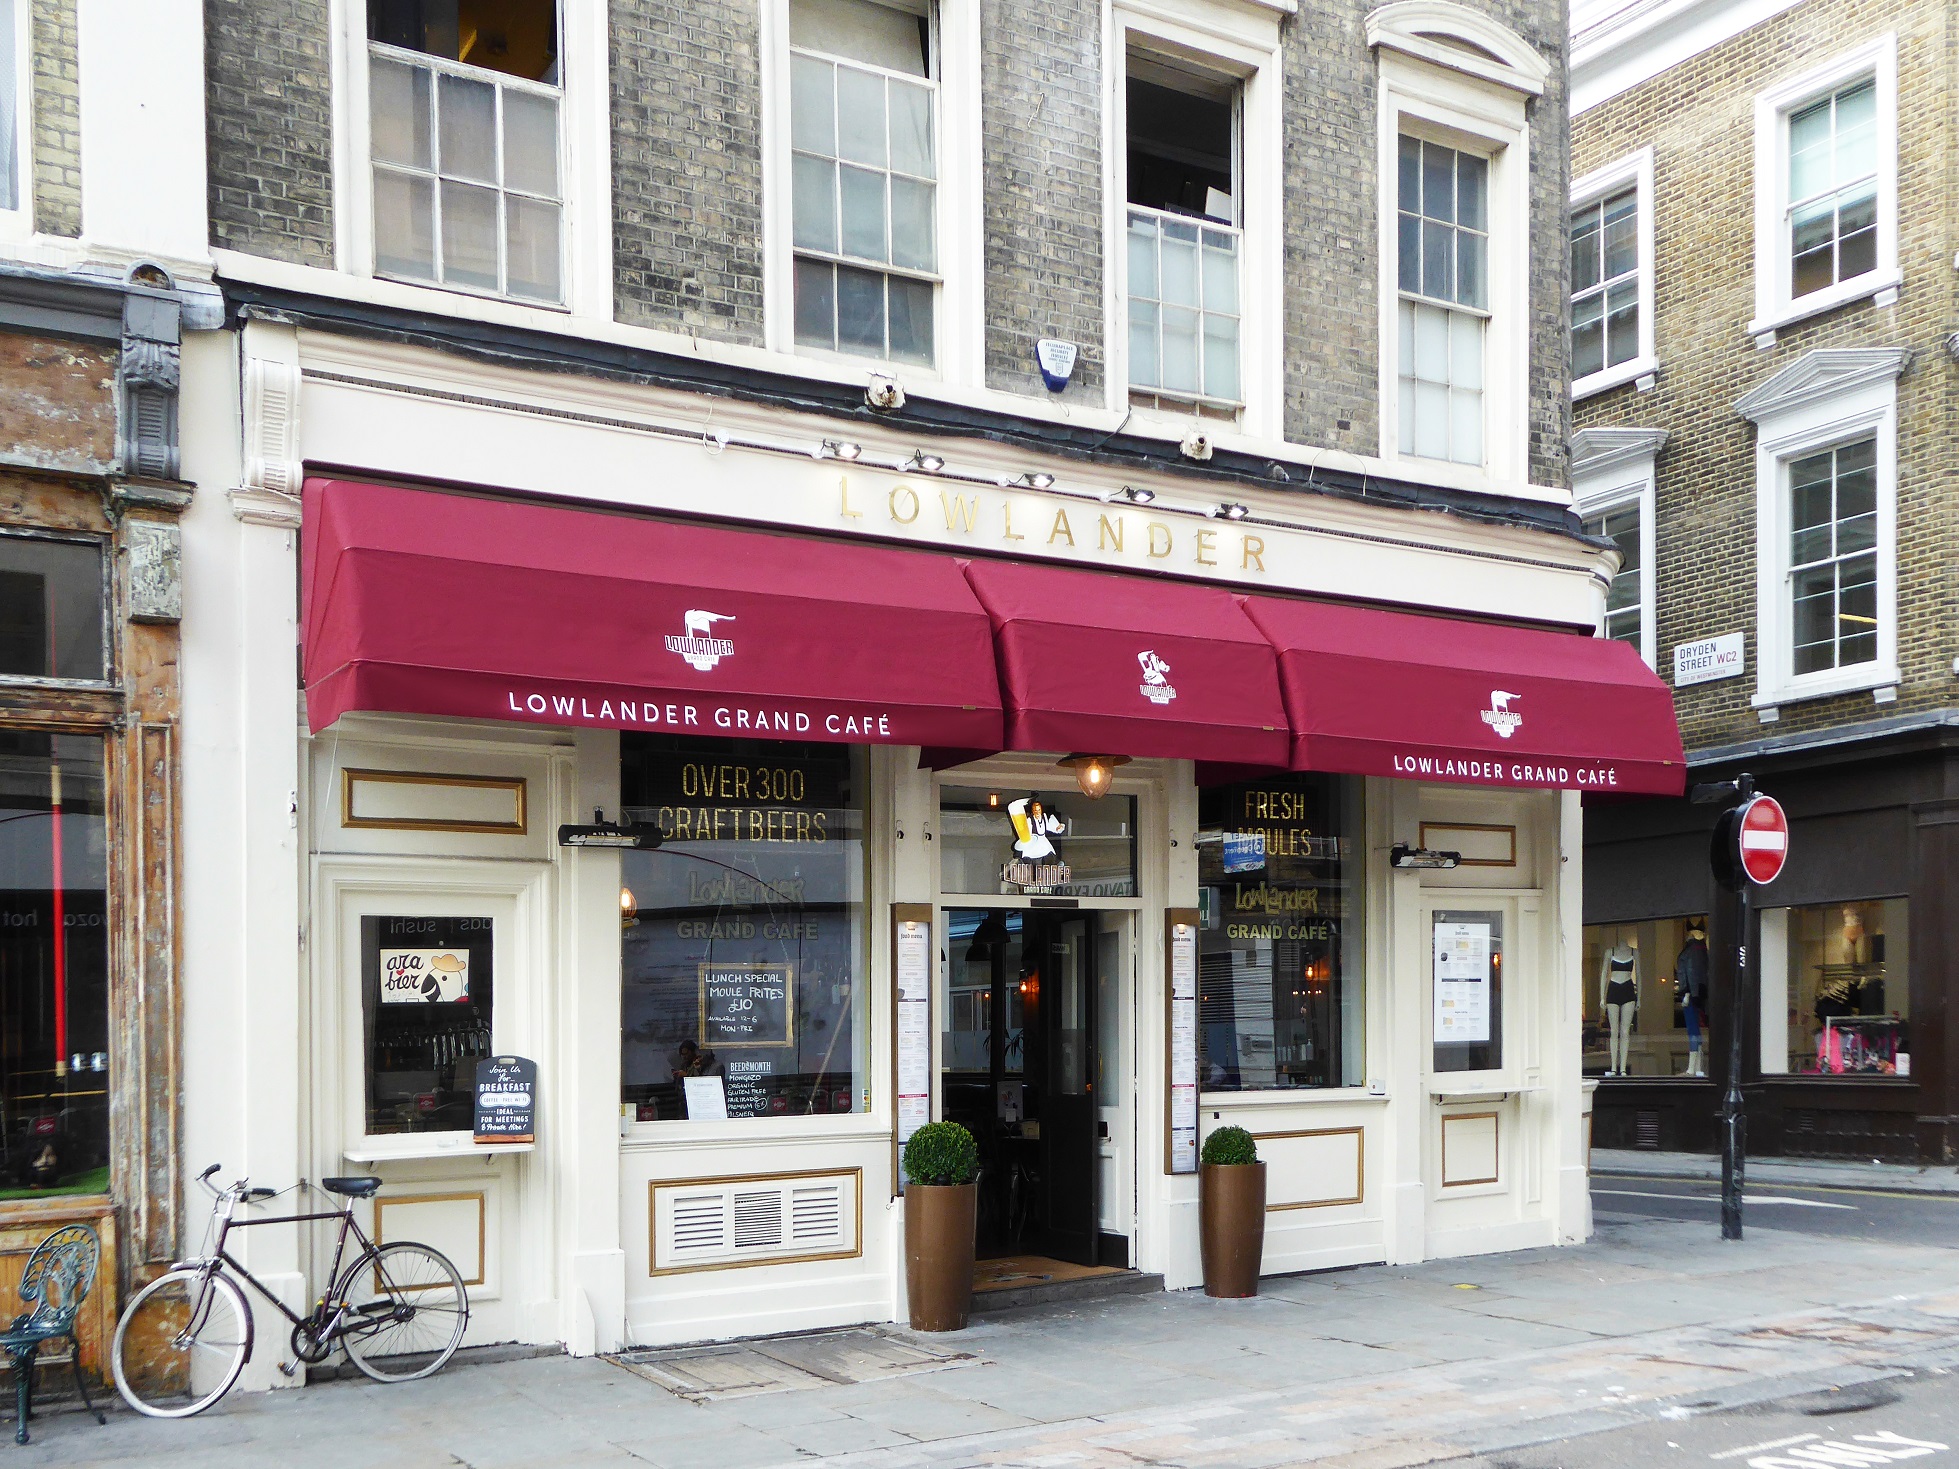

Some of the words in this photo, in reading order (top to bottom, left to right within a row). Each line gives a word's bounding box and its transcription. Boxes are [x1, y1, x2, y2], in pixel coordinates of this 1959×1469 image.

[840, 475, 1266, 573] LOWLANDER
[664, 635, 735, 656] LOWLANDER
[1680, 642, 1717, 660] DRYDEN
[1680, 656, 1713, 671] STREET
[1717, 651, 1737, 664] WC2
[508, 691, 699, 725] LOWLANDER
[715, 707, 811, 732] GRAND
[826, 713, 891, 736] CAFÉ
[1394, 755, 1503, 779] LOWLANDER
[1511, 764, 1569, 783] GRAND
[1576, 767, 1617, 785] CAFÉ
[682, 763, 750, 799] OVER
[756, 767, 804, 801] 300
[1245, 790, 1305, 820] FRESH
[658, 806, 743, 841] CRAFT
[749, 810, 827, 843] BEERS
[1003, 863, 1072, 887] LOWLANDER
[676, 921, 756, 940] GRAND
[762, 922, 819, 941] CAFE
[1226, 923, 1283, 940] GRAND
[1287, 925, 1327, 940] CAFE
[386, 954, 424, 970] ara
[385, 970, 421, 990] bier
[705, 973, 742, 983] LUNCH
[744, 973, 783, 983] SPECIAL
[709, 987, 743, 997] MOULE
[749, 987, 784, 1000] FRITES
[728, 998, 753, 1013] £10
[489, 1065, 507, 1074] Join
[510, 1065, 521, 1073] Us
[730, 1062, 746, 1072] BEER
[750, 1061, 771, 1071] MONTH
[479, 1082, 531, 1092] BREAKFAST
[729, 1074, 762, 1082] MONGOZO
[480, 1115, 493, 1123] FOR
[495, 1115, 529, 1123] MEETINGS
[486, 1123, 507, 1131] Private
